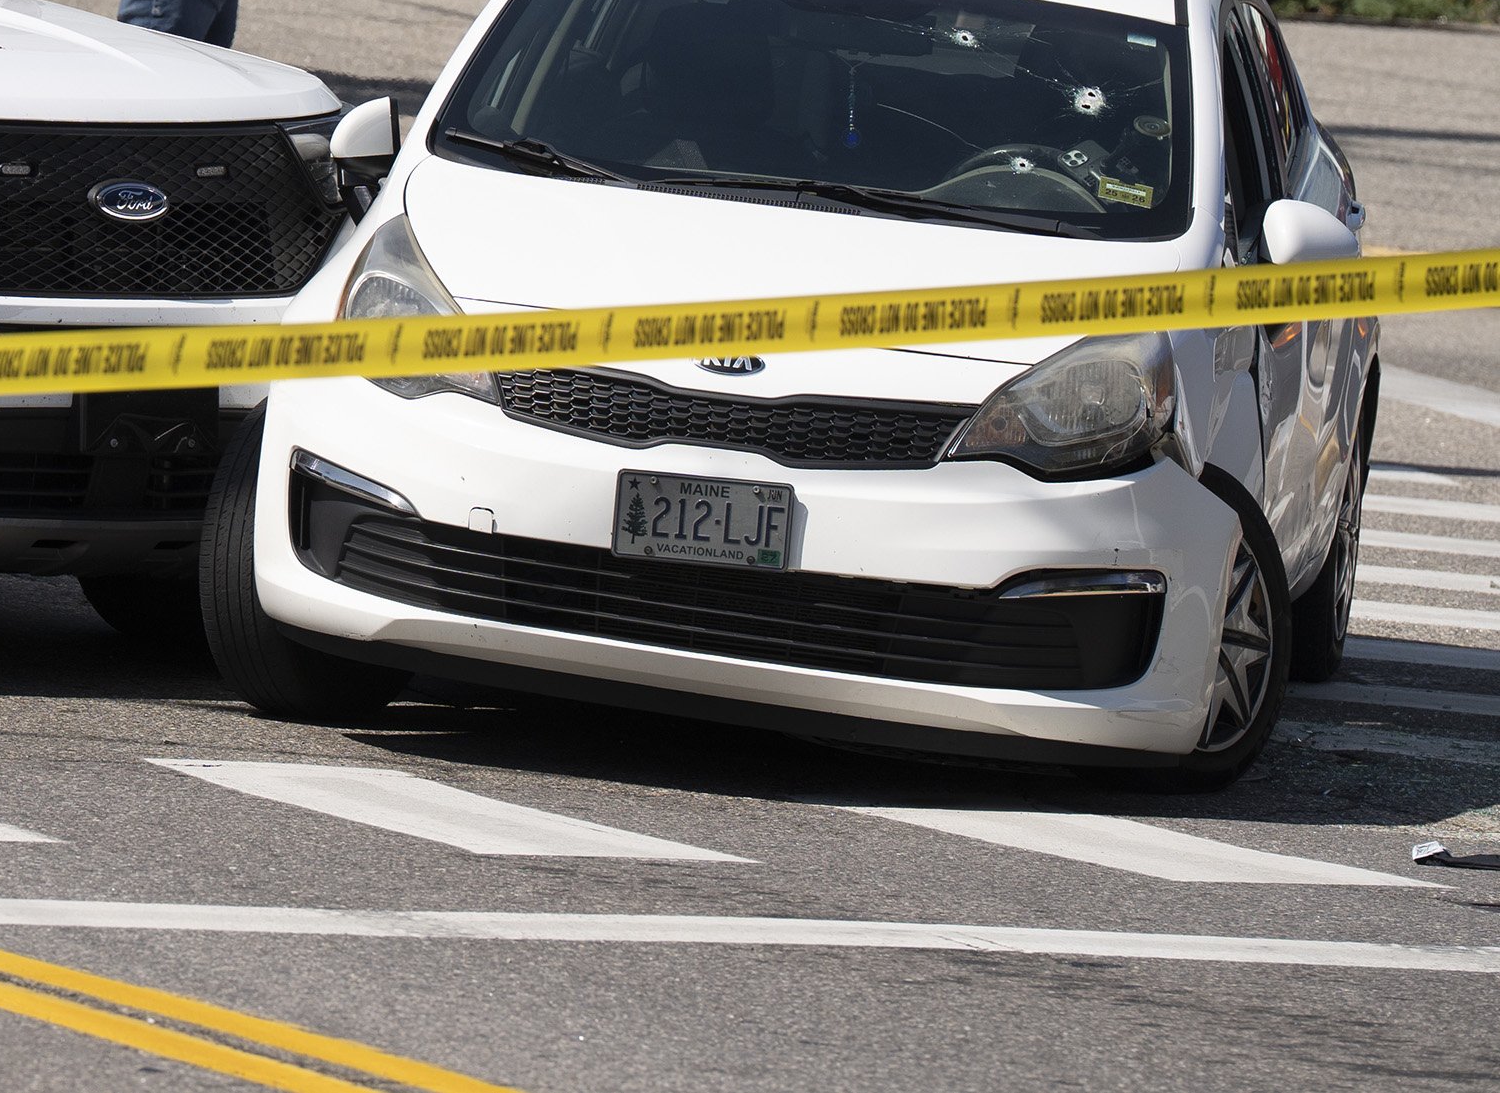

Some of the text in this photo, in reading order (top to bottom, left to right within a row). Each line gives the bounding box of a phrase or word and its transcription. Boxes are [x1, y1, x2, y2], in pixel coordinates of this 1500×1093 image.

[116, 189, 154, 211] Ford
[1234, 270, 1378, 311] POLICE LINE DO NOT CROSS
[1423, 260, 1499, 297] DO NOT CROSS
[838, 297, 990, 337] POLICE LINE DO NOT CROSS
[1040, 284, 1187, 324] POLICE LINE DO NOT CROSS
[421, 321, 581, 360] POLICE LINE DO NOT CROSS
[632, 310, 787, 349] POLICE LINE DO NOT CROSS
[26, 347, 51, 379] NOT
[53, 346, 71, 377] DO
[74, 345, 102, 377] LINE
[104, 343, 150, 375] POLICE
[204, 332, 369, 371] POLICE LINE DO NOT CROSS
[679, 482, 731, 499] MAINE
[767, 488, 783, 501] JUN
[651, 496, 785, 548] 212-LJF
[656, 543, 745, 561] VACATIONLAND
